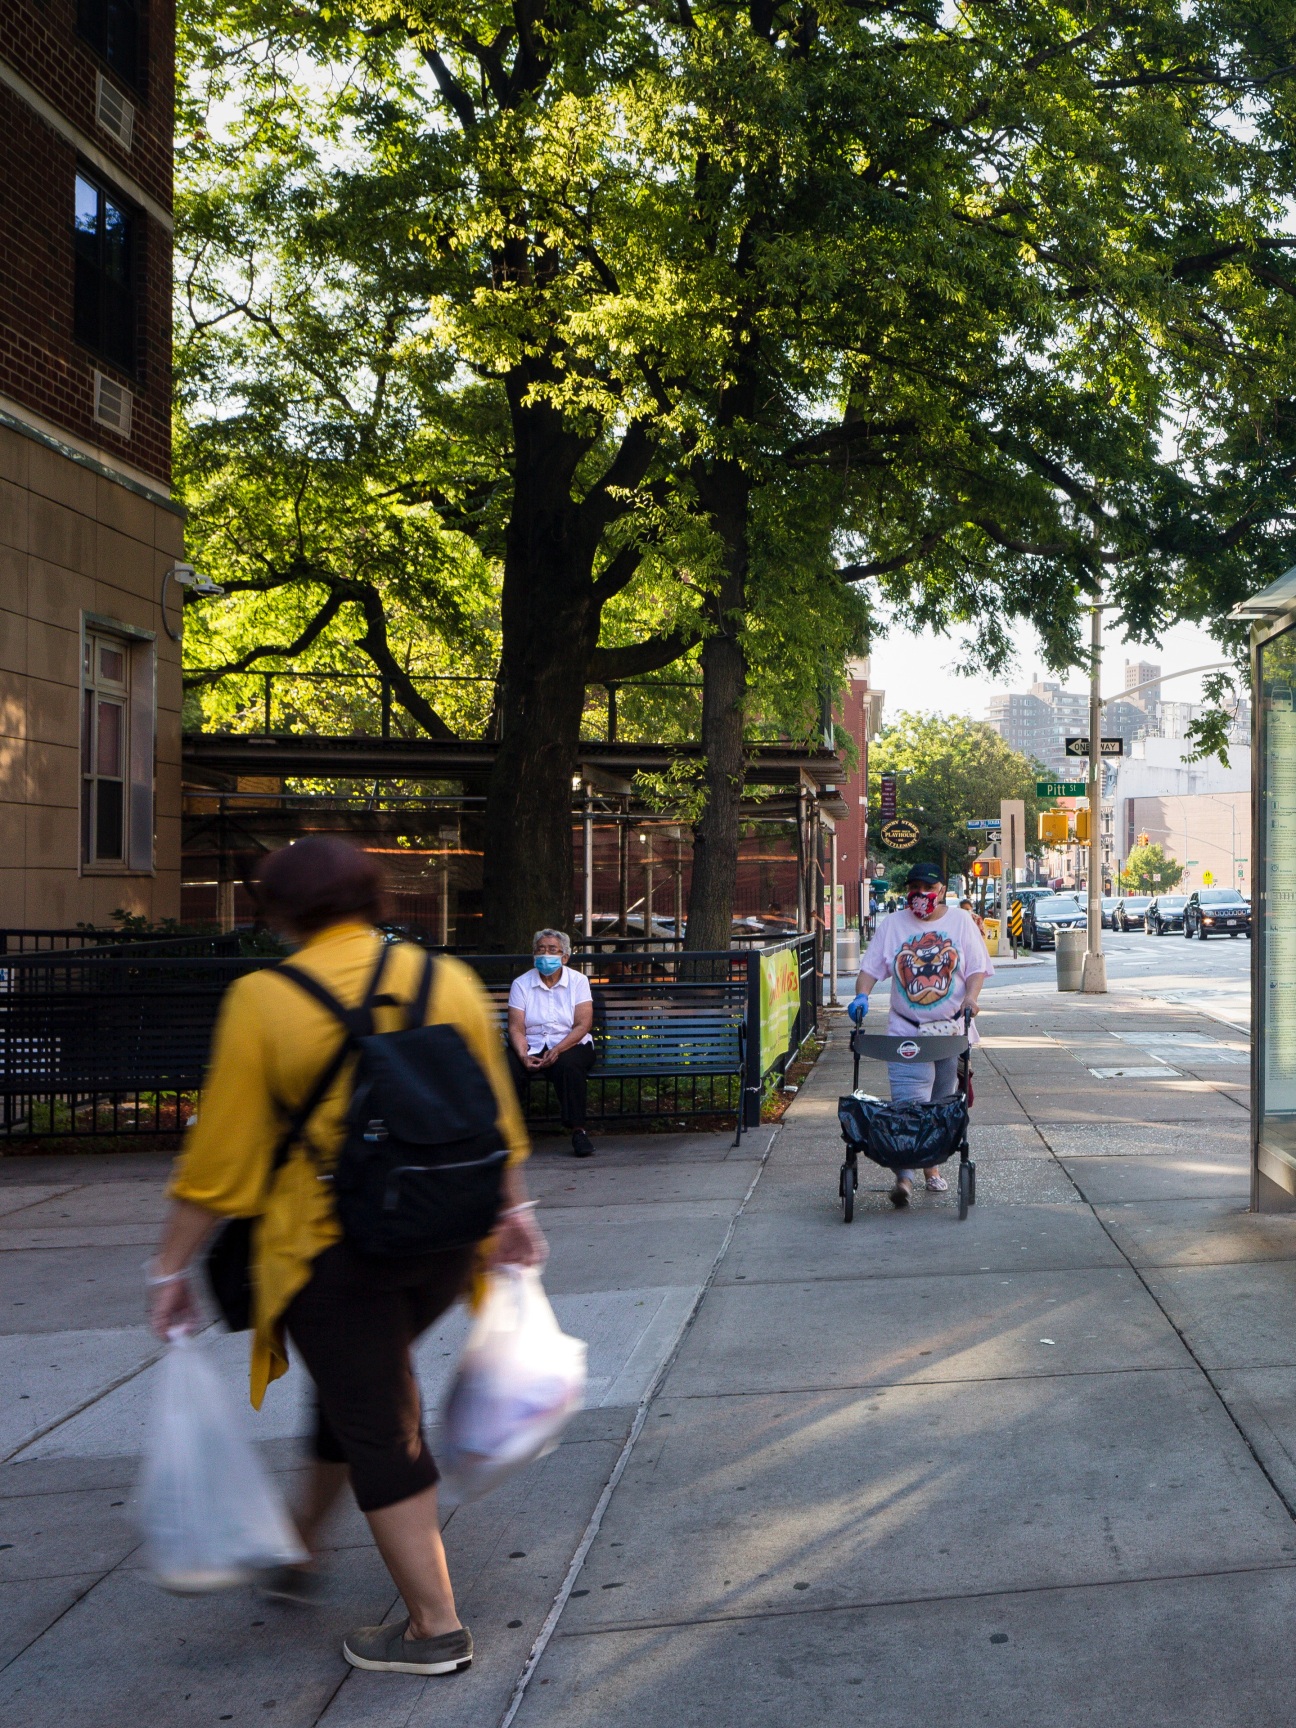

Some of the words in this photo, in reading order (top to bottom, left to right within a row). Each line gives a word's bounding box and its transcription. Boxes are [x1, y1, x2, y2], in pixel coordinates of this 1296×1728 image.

[1074, 742, 1090, 751] ONE
[1047, 783, 1066, 796] Pitt
[1069, 784, 1077, 792] St
